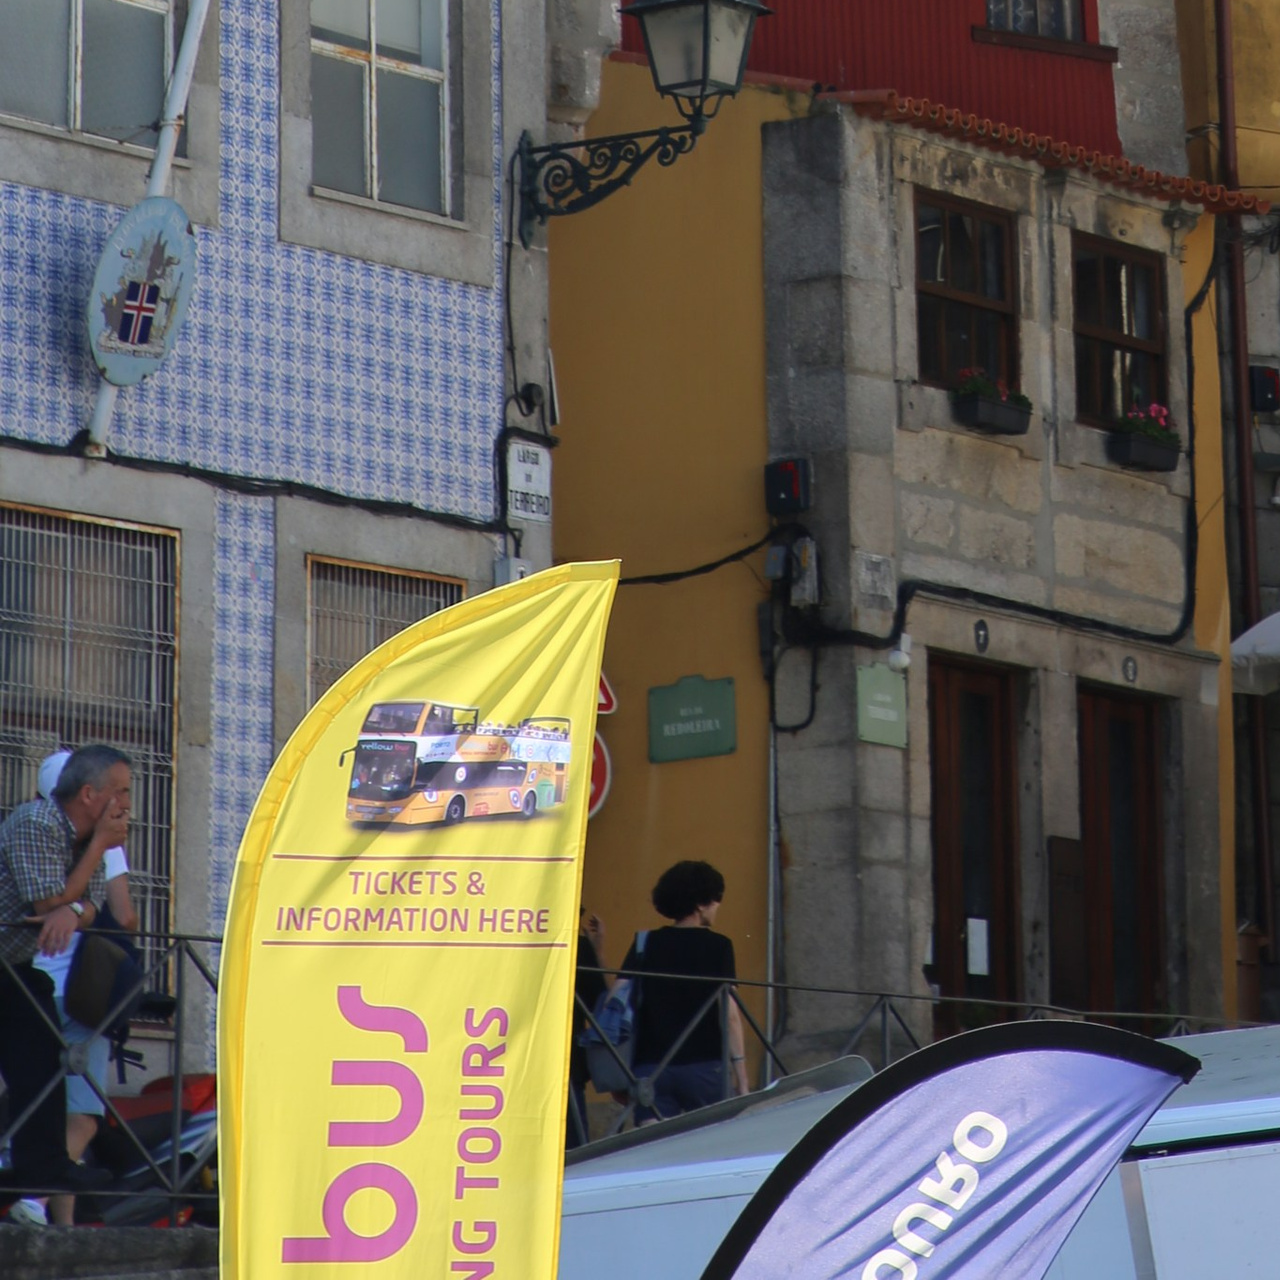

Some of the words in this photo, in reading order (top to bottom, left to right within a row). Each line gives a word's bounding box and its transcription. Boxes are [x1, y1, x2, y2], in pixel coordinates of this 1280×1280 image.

[276, 906, 469, 933] INFORMATION
[478, 908, 550, 934] HERE
[349, 871, 457, 896] TICKETS
[466, 871, 486, 896] &
[281, 985, 429, 1264] bus
[454, 1006, 509, 1200] TOURS
